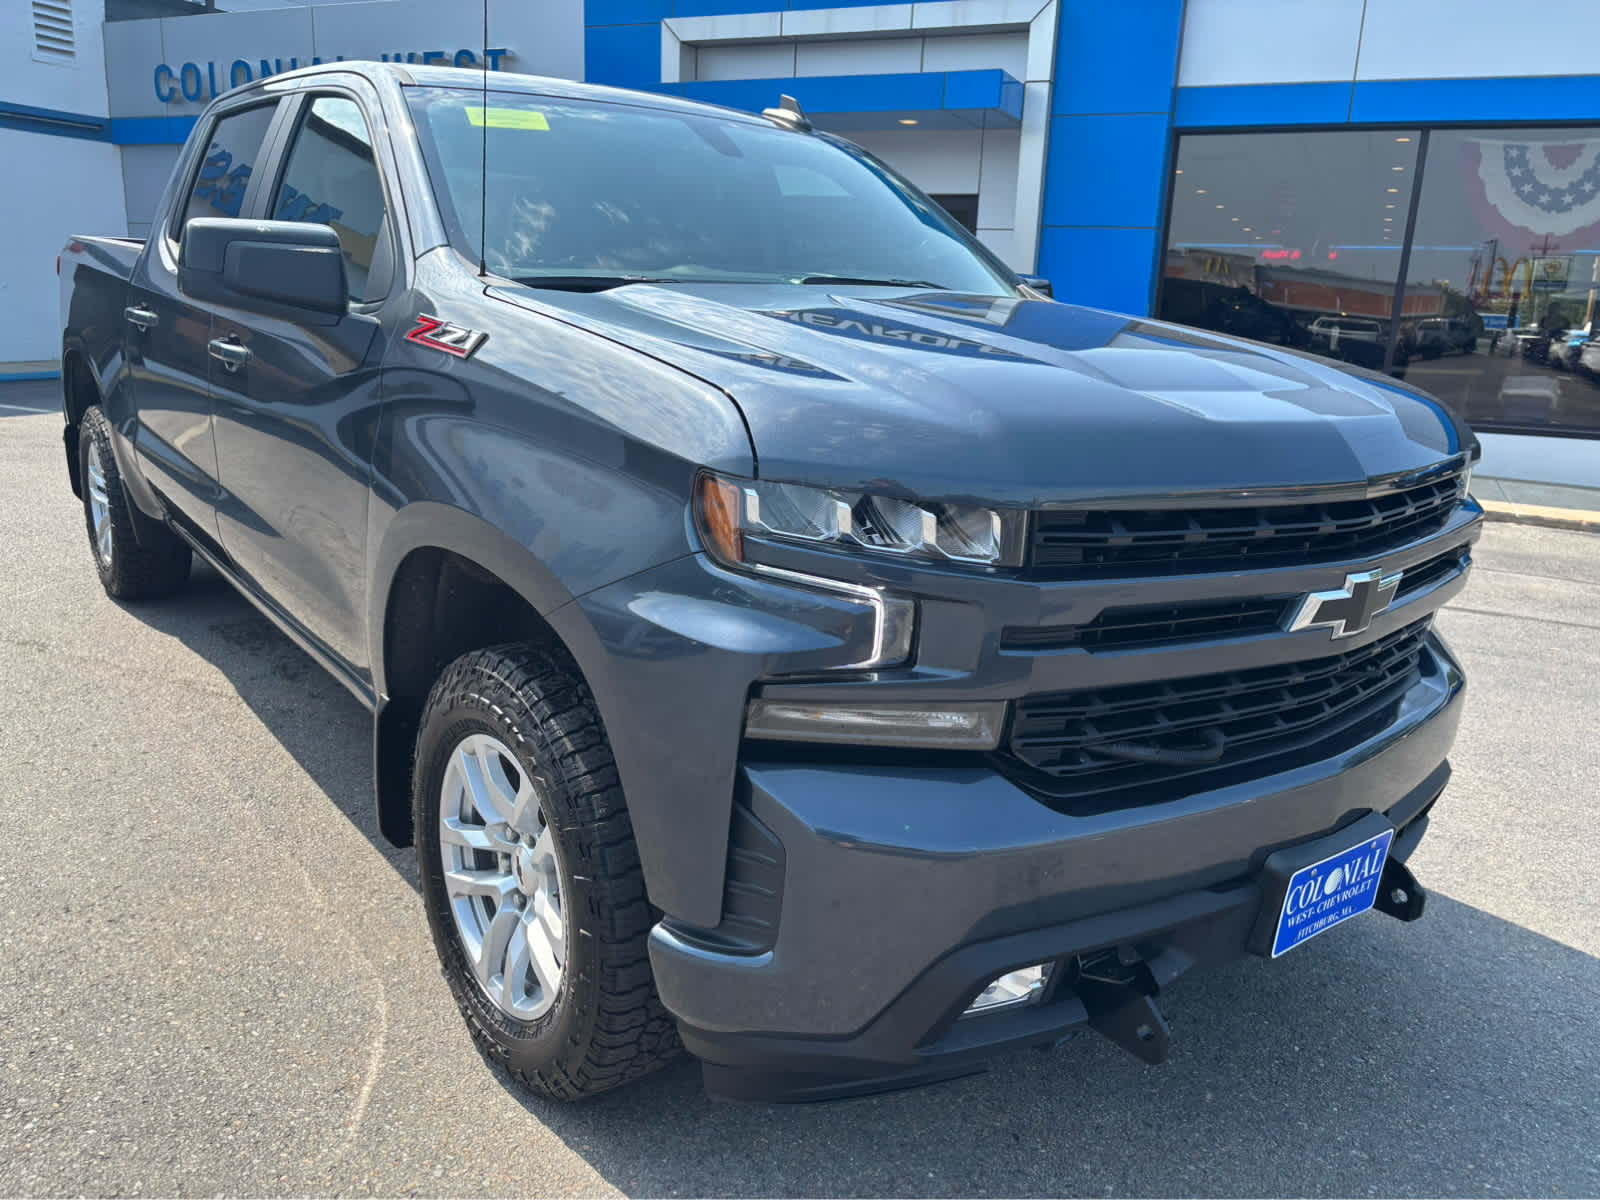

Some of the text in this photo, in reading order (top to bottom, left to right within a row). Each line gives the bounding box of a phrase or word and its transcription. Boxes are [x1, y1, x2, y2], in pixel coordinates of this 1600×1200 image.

[404, 312, 490, 360] Z71
[1287, 848, 1383, 915] COLONIAL
[1317, 879, 1373, 913] CHEVROLET
